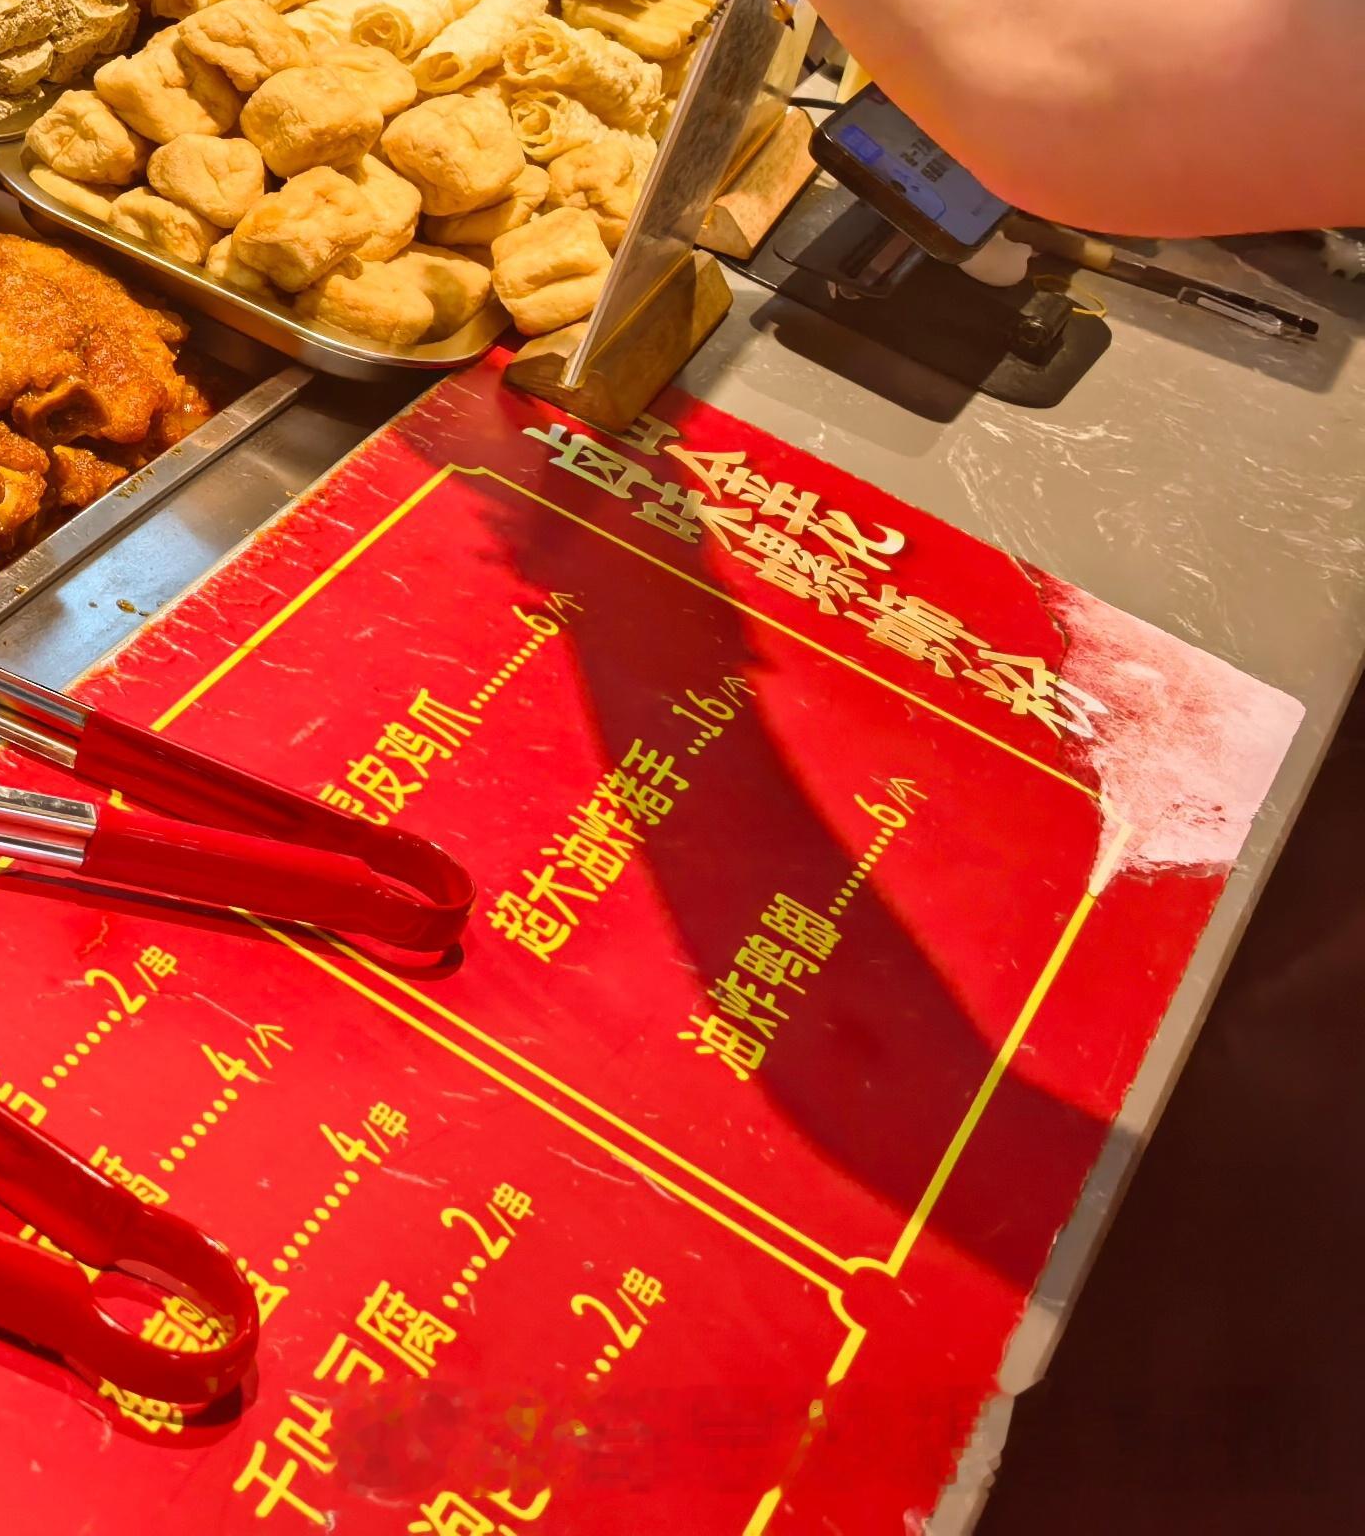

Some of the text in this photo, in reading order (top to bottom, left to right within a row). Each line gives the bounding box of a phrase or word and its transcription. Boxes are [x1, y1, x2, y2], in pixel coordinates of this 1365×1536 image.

[522, 424, 1109, 739] 卤味螺蛳粉
[486, 738, 690, 963] 超大油炸猪手
[676, 892, 842, 1081] 油炸鸭脚
